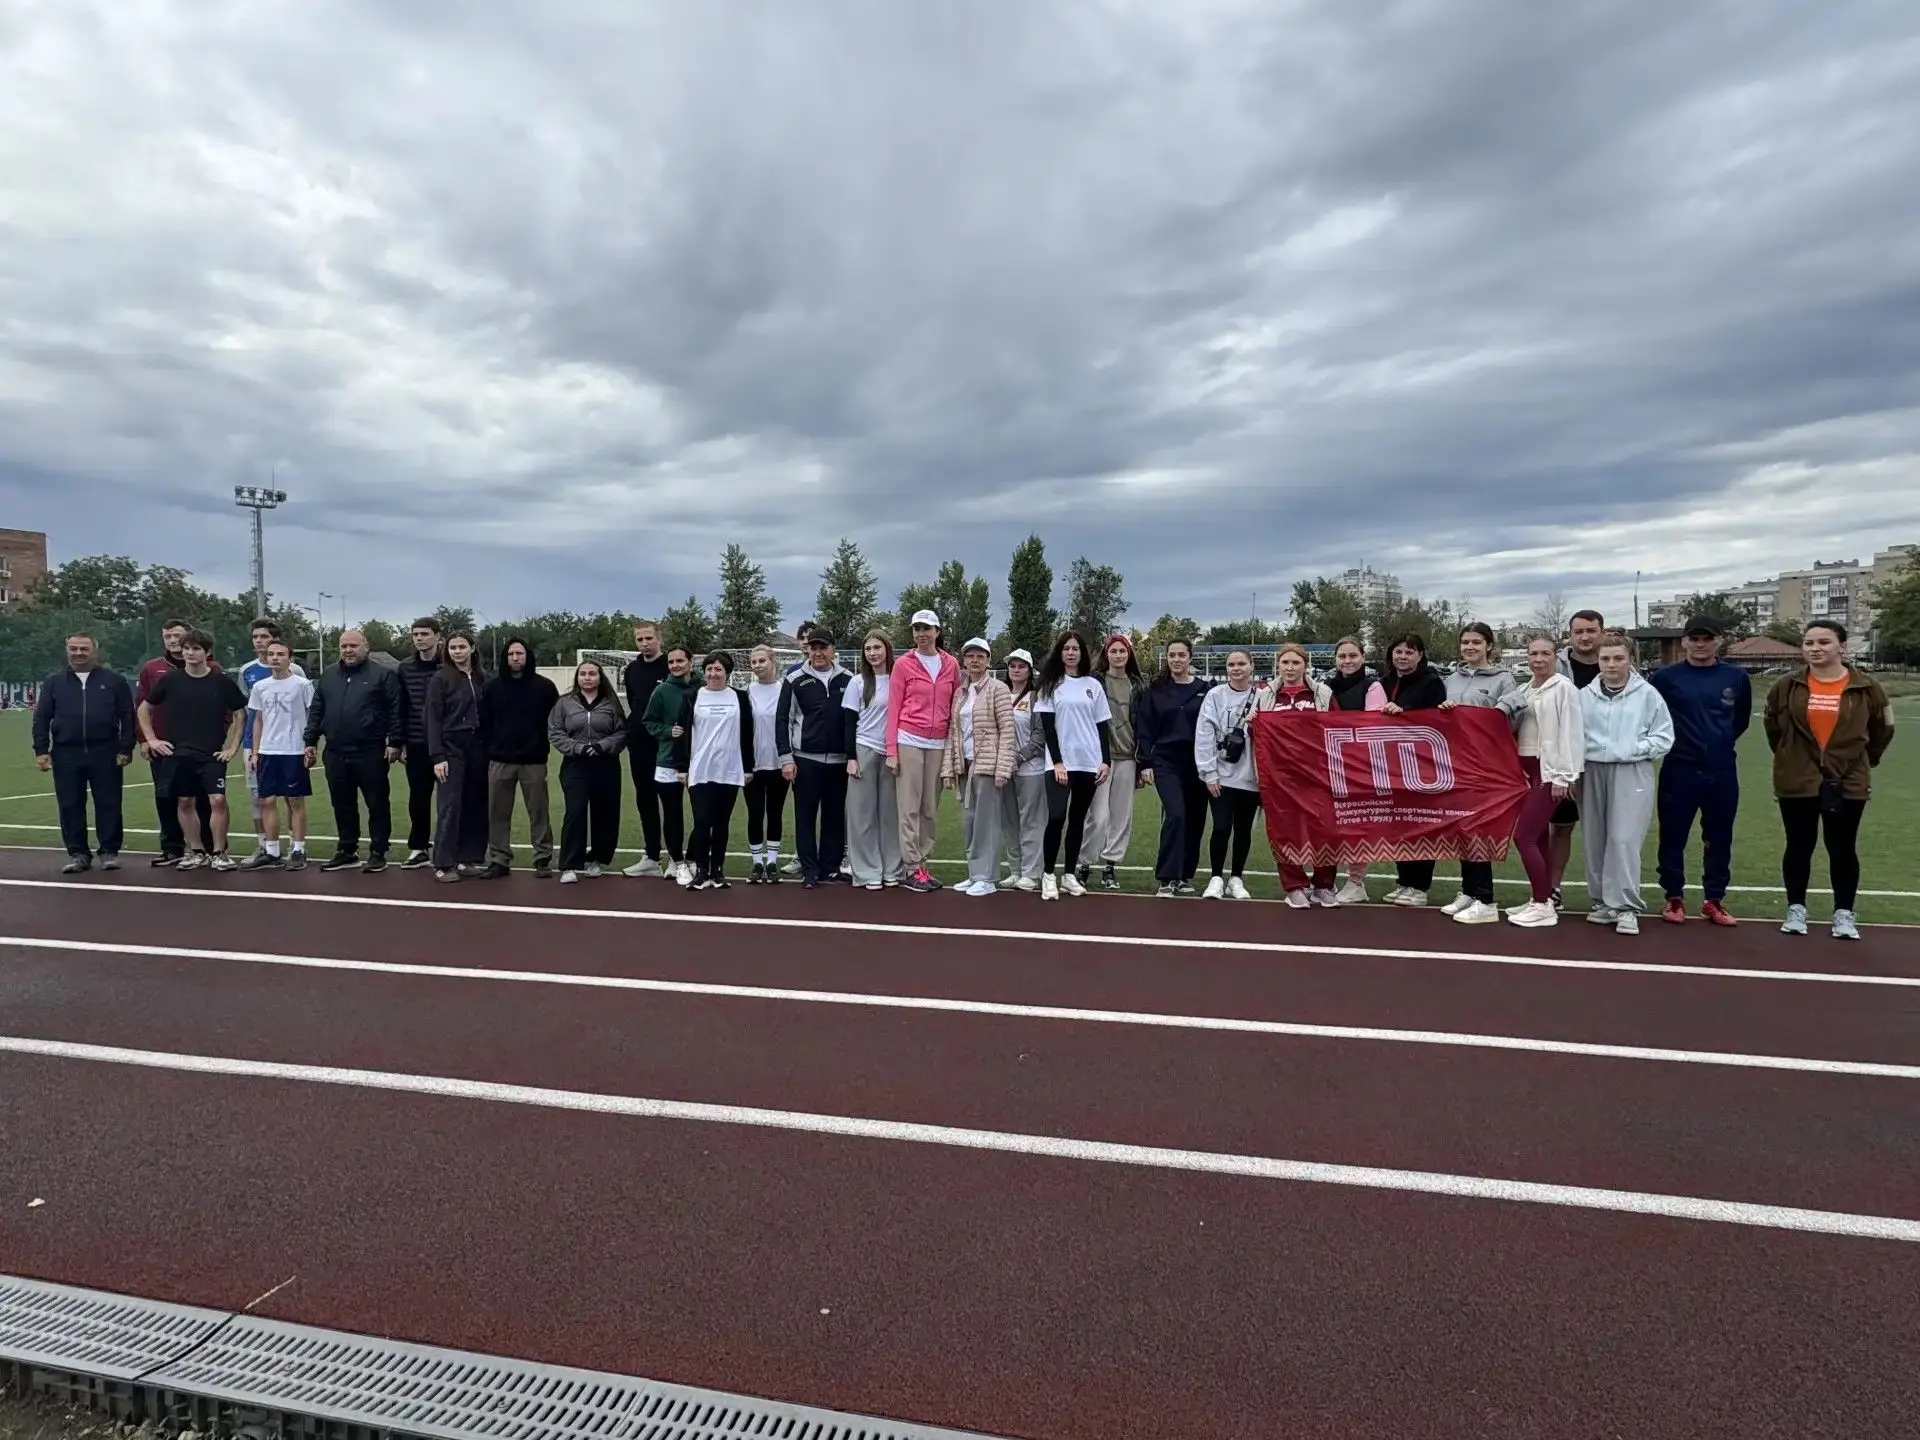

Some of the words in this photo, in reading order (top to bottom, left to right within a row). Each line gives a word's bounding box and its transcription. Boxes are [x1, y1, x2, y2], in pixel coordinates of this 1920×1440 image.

[1324, 725, 1456, 798] ГТО
[216, 777, 225, 789] 3
[1333, 799, 1394, 809] Всероссийский
[1369, 815, 1393, 823] труду
